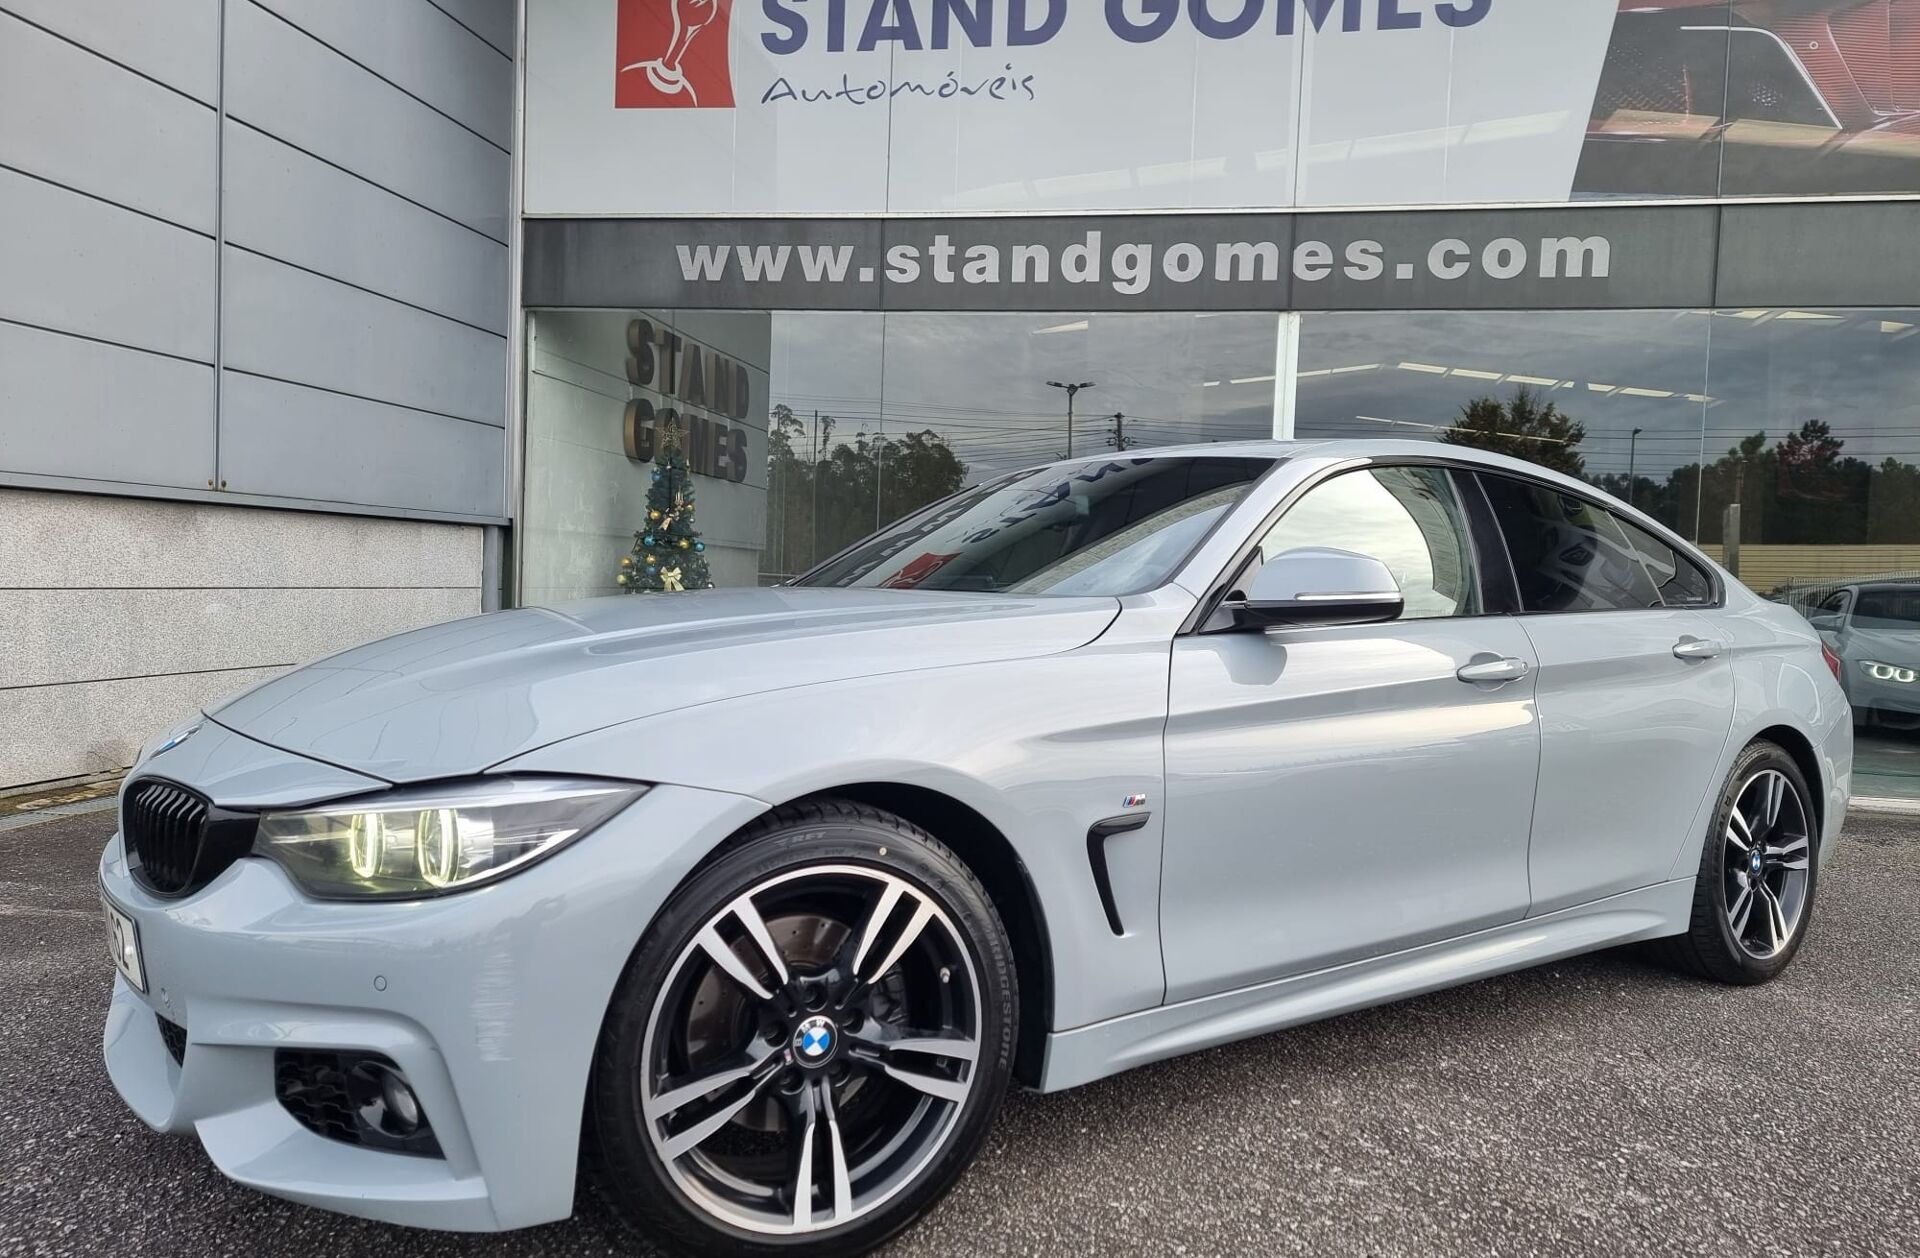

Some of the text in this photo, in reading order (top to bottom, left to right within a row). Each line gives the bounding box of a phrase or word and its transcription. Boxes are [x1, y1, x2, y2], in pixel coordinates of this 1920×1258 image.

[761, 62, 1035, 105] Automóveis
[675, 231, 1611, 296] www.standgomes.com
[625, 318, 750, 419] STAND
[623, 398, 748, 484] GOMES
